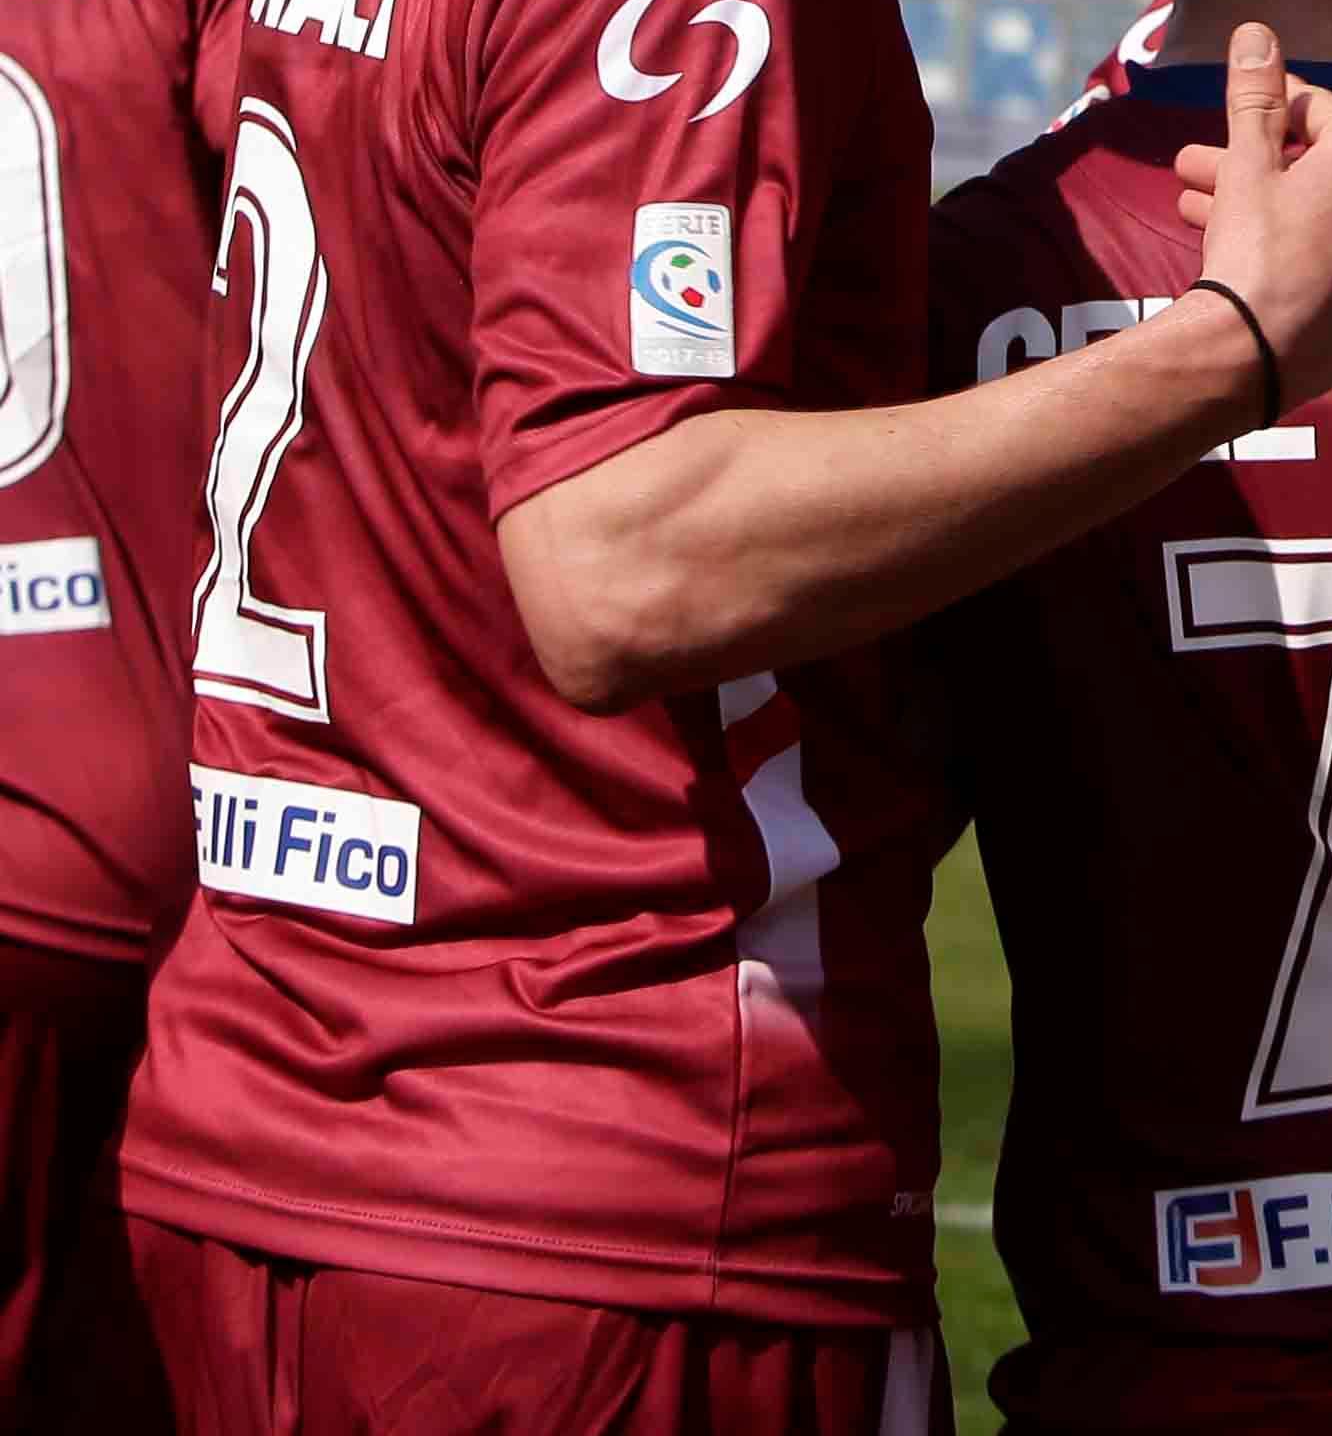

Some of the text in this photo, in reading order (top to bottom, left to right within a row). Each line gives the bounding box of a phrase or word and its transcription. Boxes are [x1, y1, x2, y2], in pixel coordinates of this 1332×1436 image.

[193, 96, 330, 724] 2
[0, 561, 102, 613] ico
[273, 805, 409, 897] Fico
